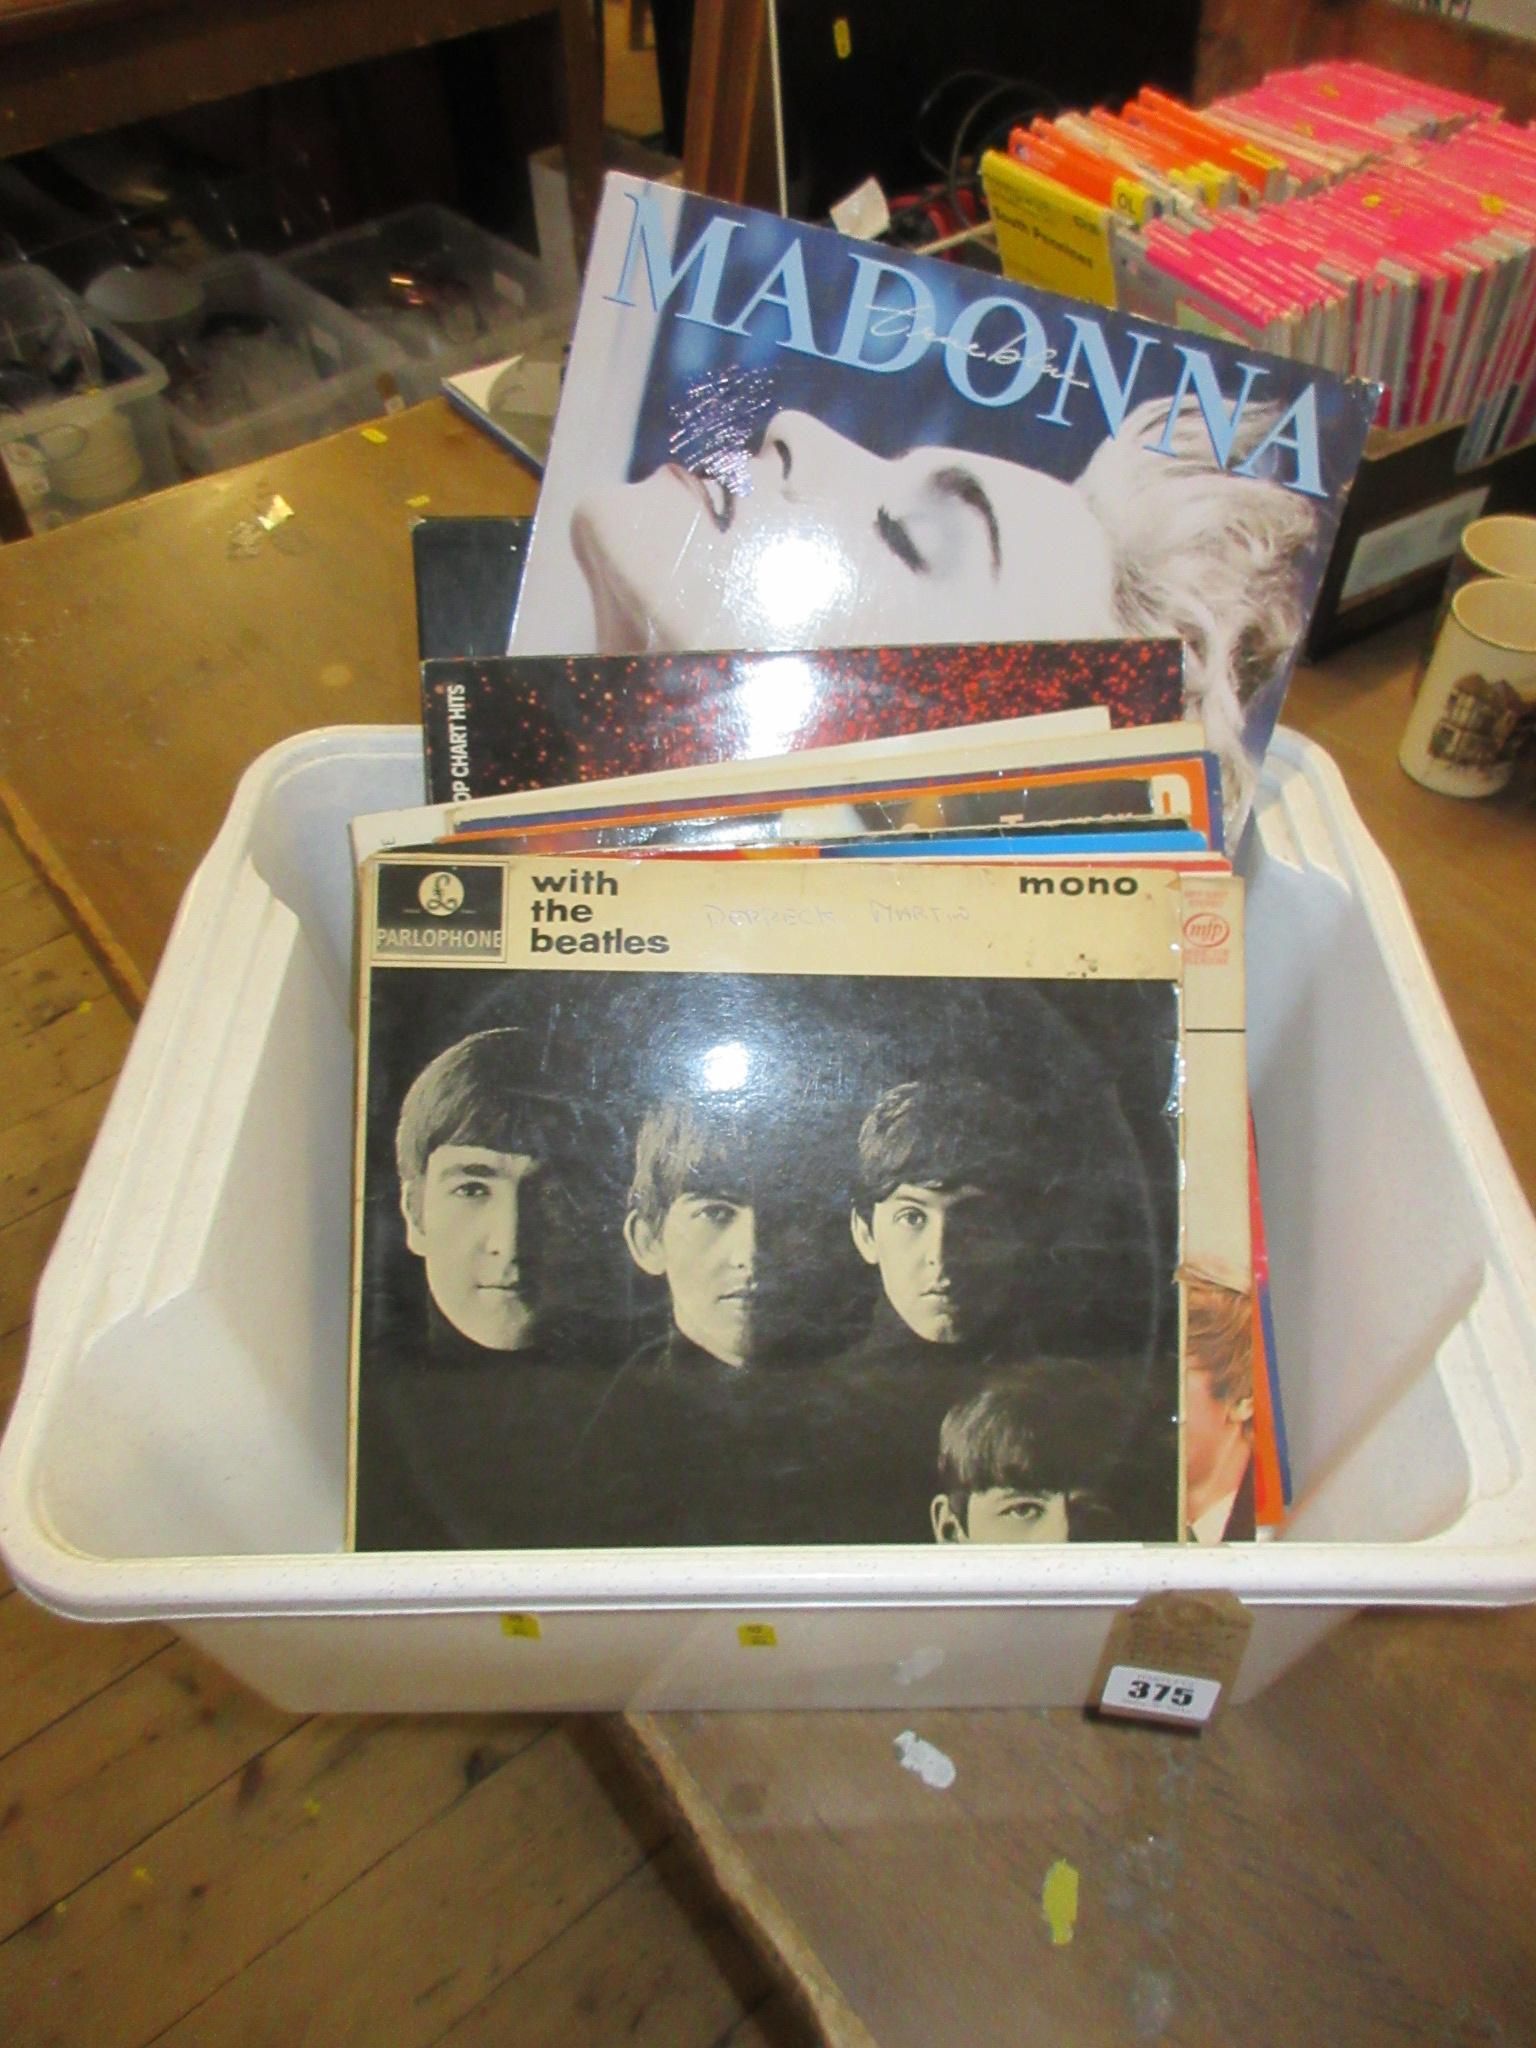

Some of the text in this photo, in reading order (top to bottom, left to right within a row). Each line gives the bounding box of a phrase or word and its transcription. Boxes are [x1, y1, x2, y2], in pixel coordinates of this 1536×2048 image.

[602, 192, 1330, 499] MADONNA
[446, 684, 467, 720] HITS
[449, 725, 470, 778] CHART
[530, 869, 619, 896] with
[1018, 875, 1139, 897] mono
[530, 899, 594, 923] the
[377, 928, 502, 948] PARLOPHONE
[530, 928, 671, 955] beatles
[1127, 1679, 1195, 1706] 375
